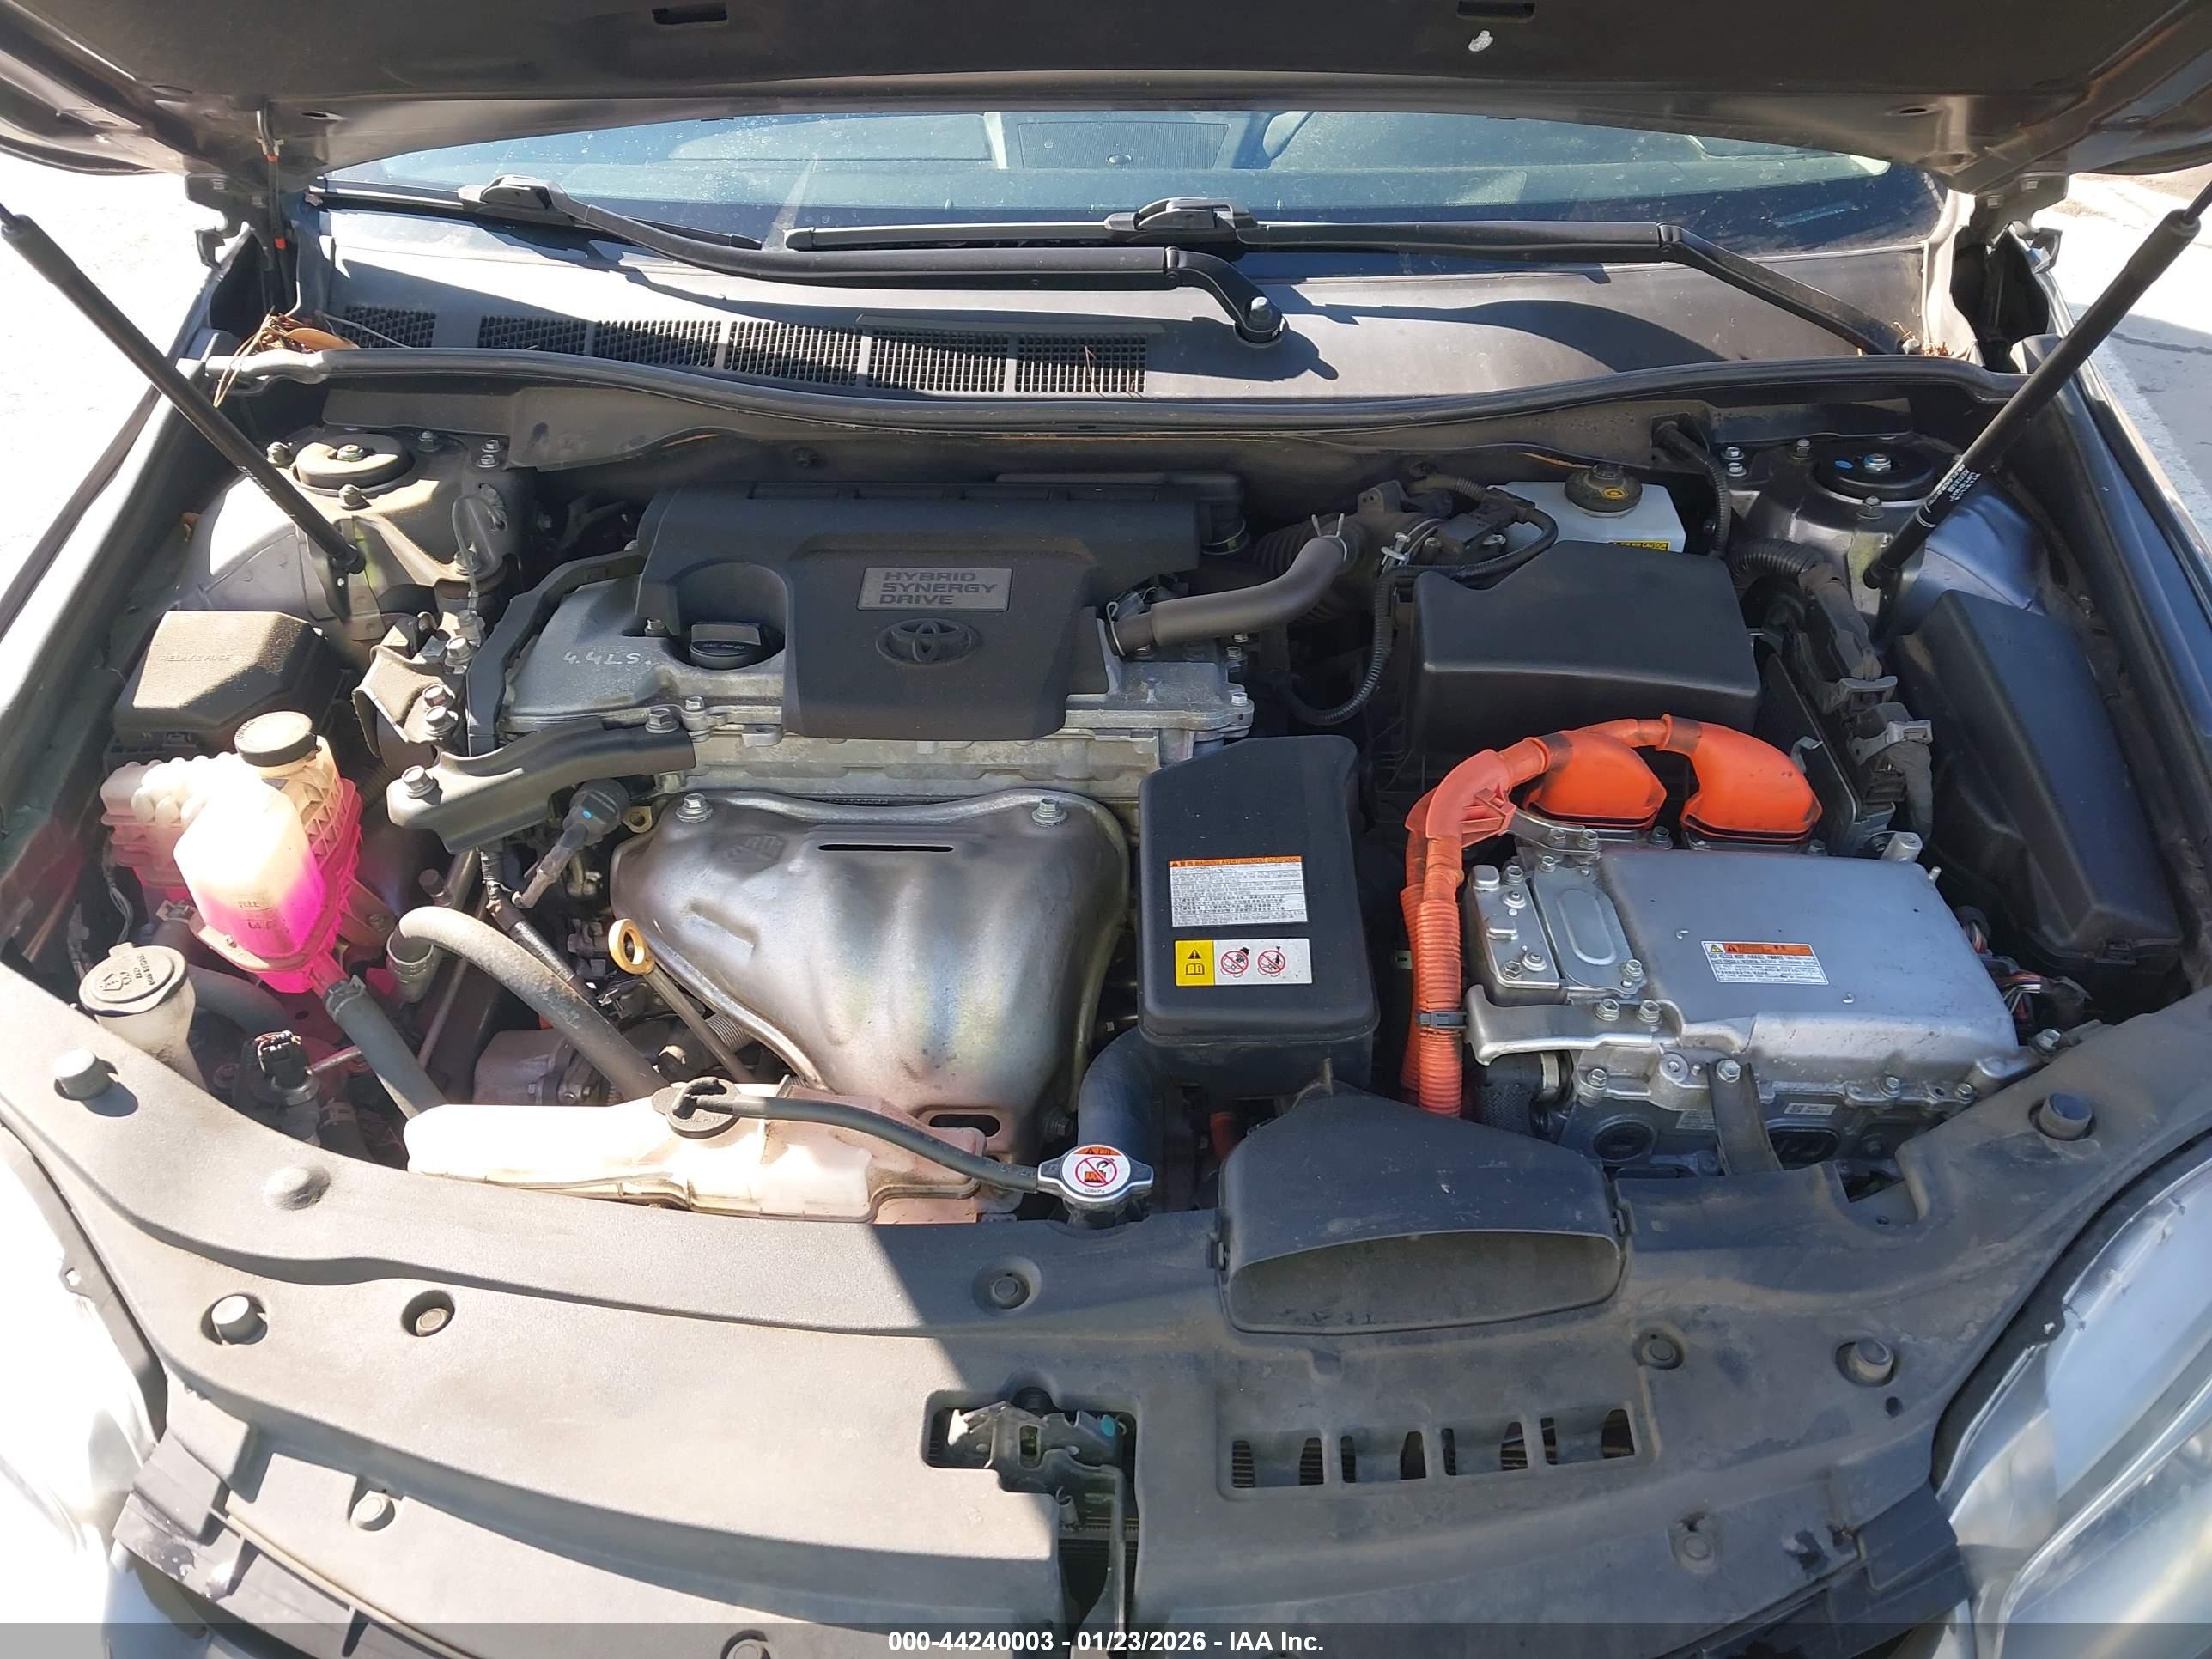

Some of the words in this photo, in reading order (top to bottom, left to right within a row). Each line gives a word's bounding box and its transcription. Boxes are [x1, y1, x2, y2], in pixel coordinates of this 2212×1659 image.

[884, 571, 976, 582] HYBRID
[880, 582, 998, 593] SYNERGY
[878, 594, 954, 605] DRIVE
